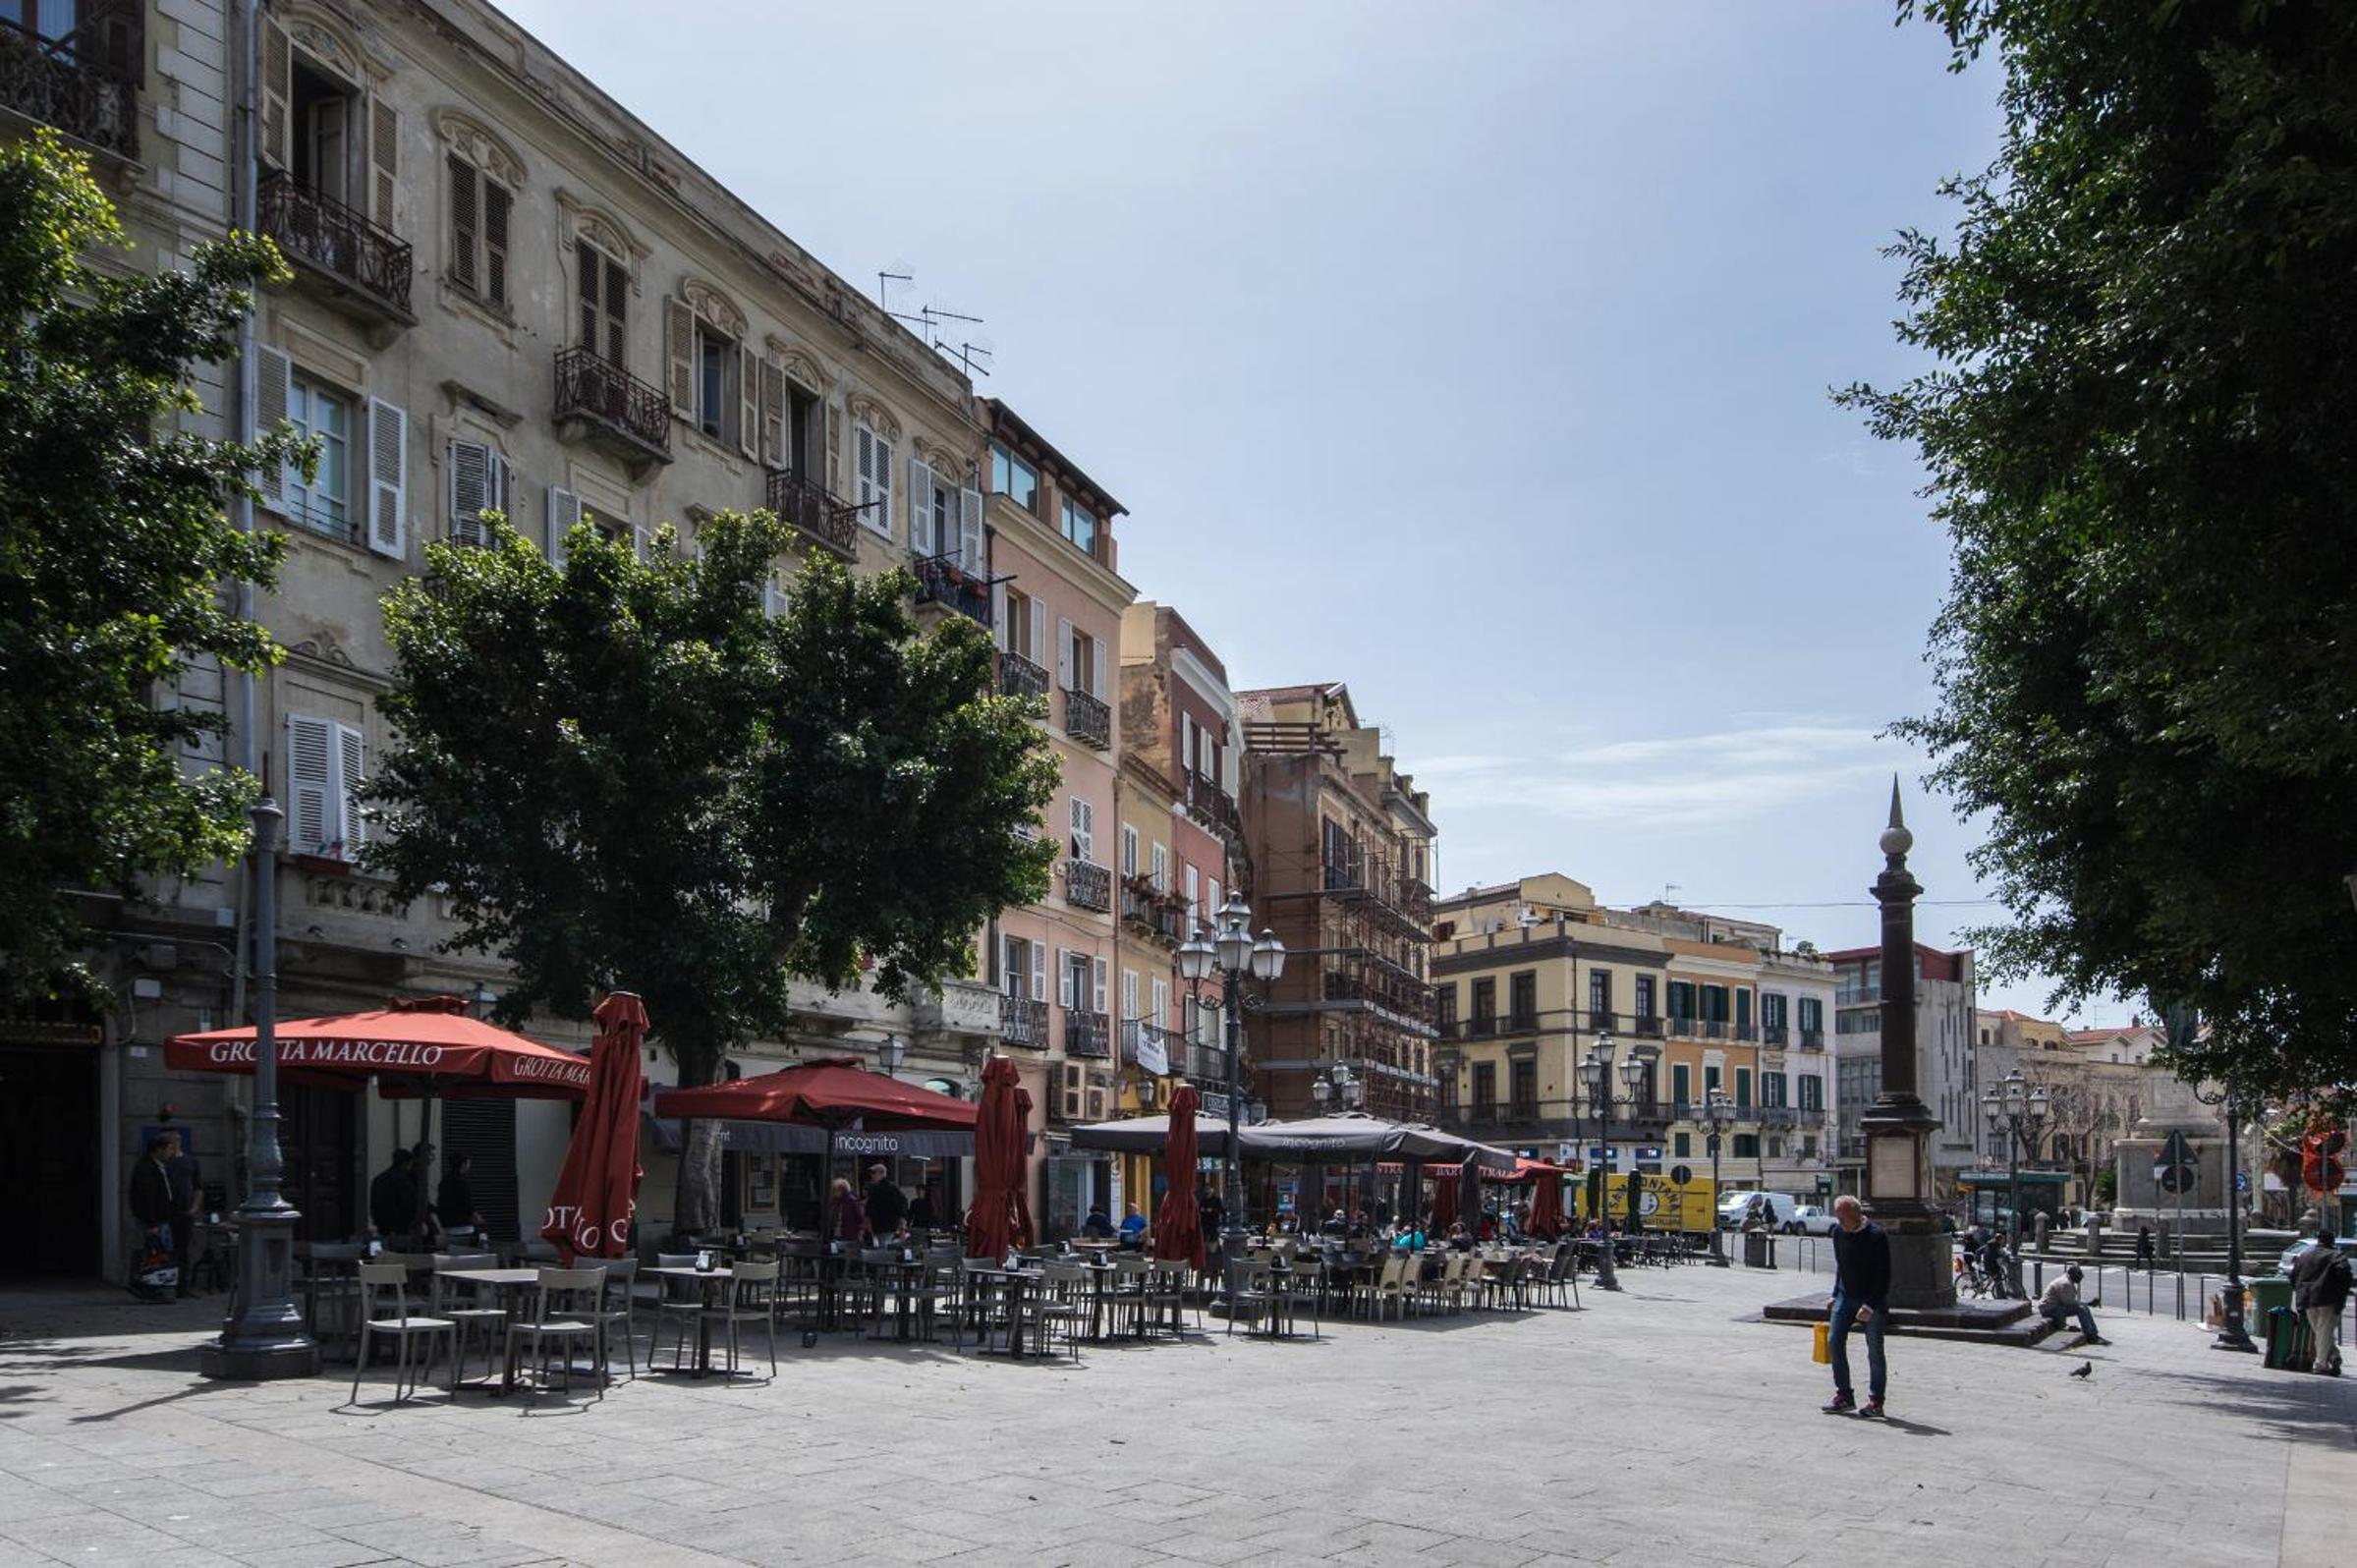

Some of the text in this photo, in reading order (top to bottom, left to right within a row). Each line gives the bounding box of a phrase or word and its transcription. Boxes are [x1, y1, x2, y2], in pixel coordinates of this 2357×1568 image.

[210, 1039, 442, 1065] GROTA MARCELLO
[514, 1056, 562, 1081] GROTTA
[835, 1132, 898, 1153] incognito
[1282, 1138, 1346, 1150] incognito
[1435, 1167, 1458, 1177] BAR
